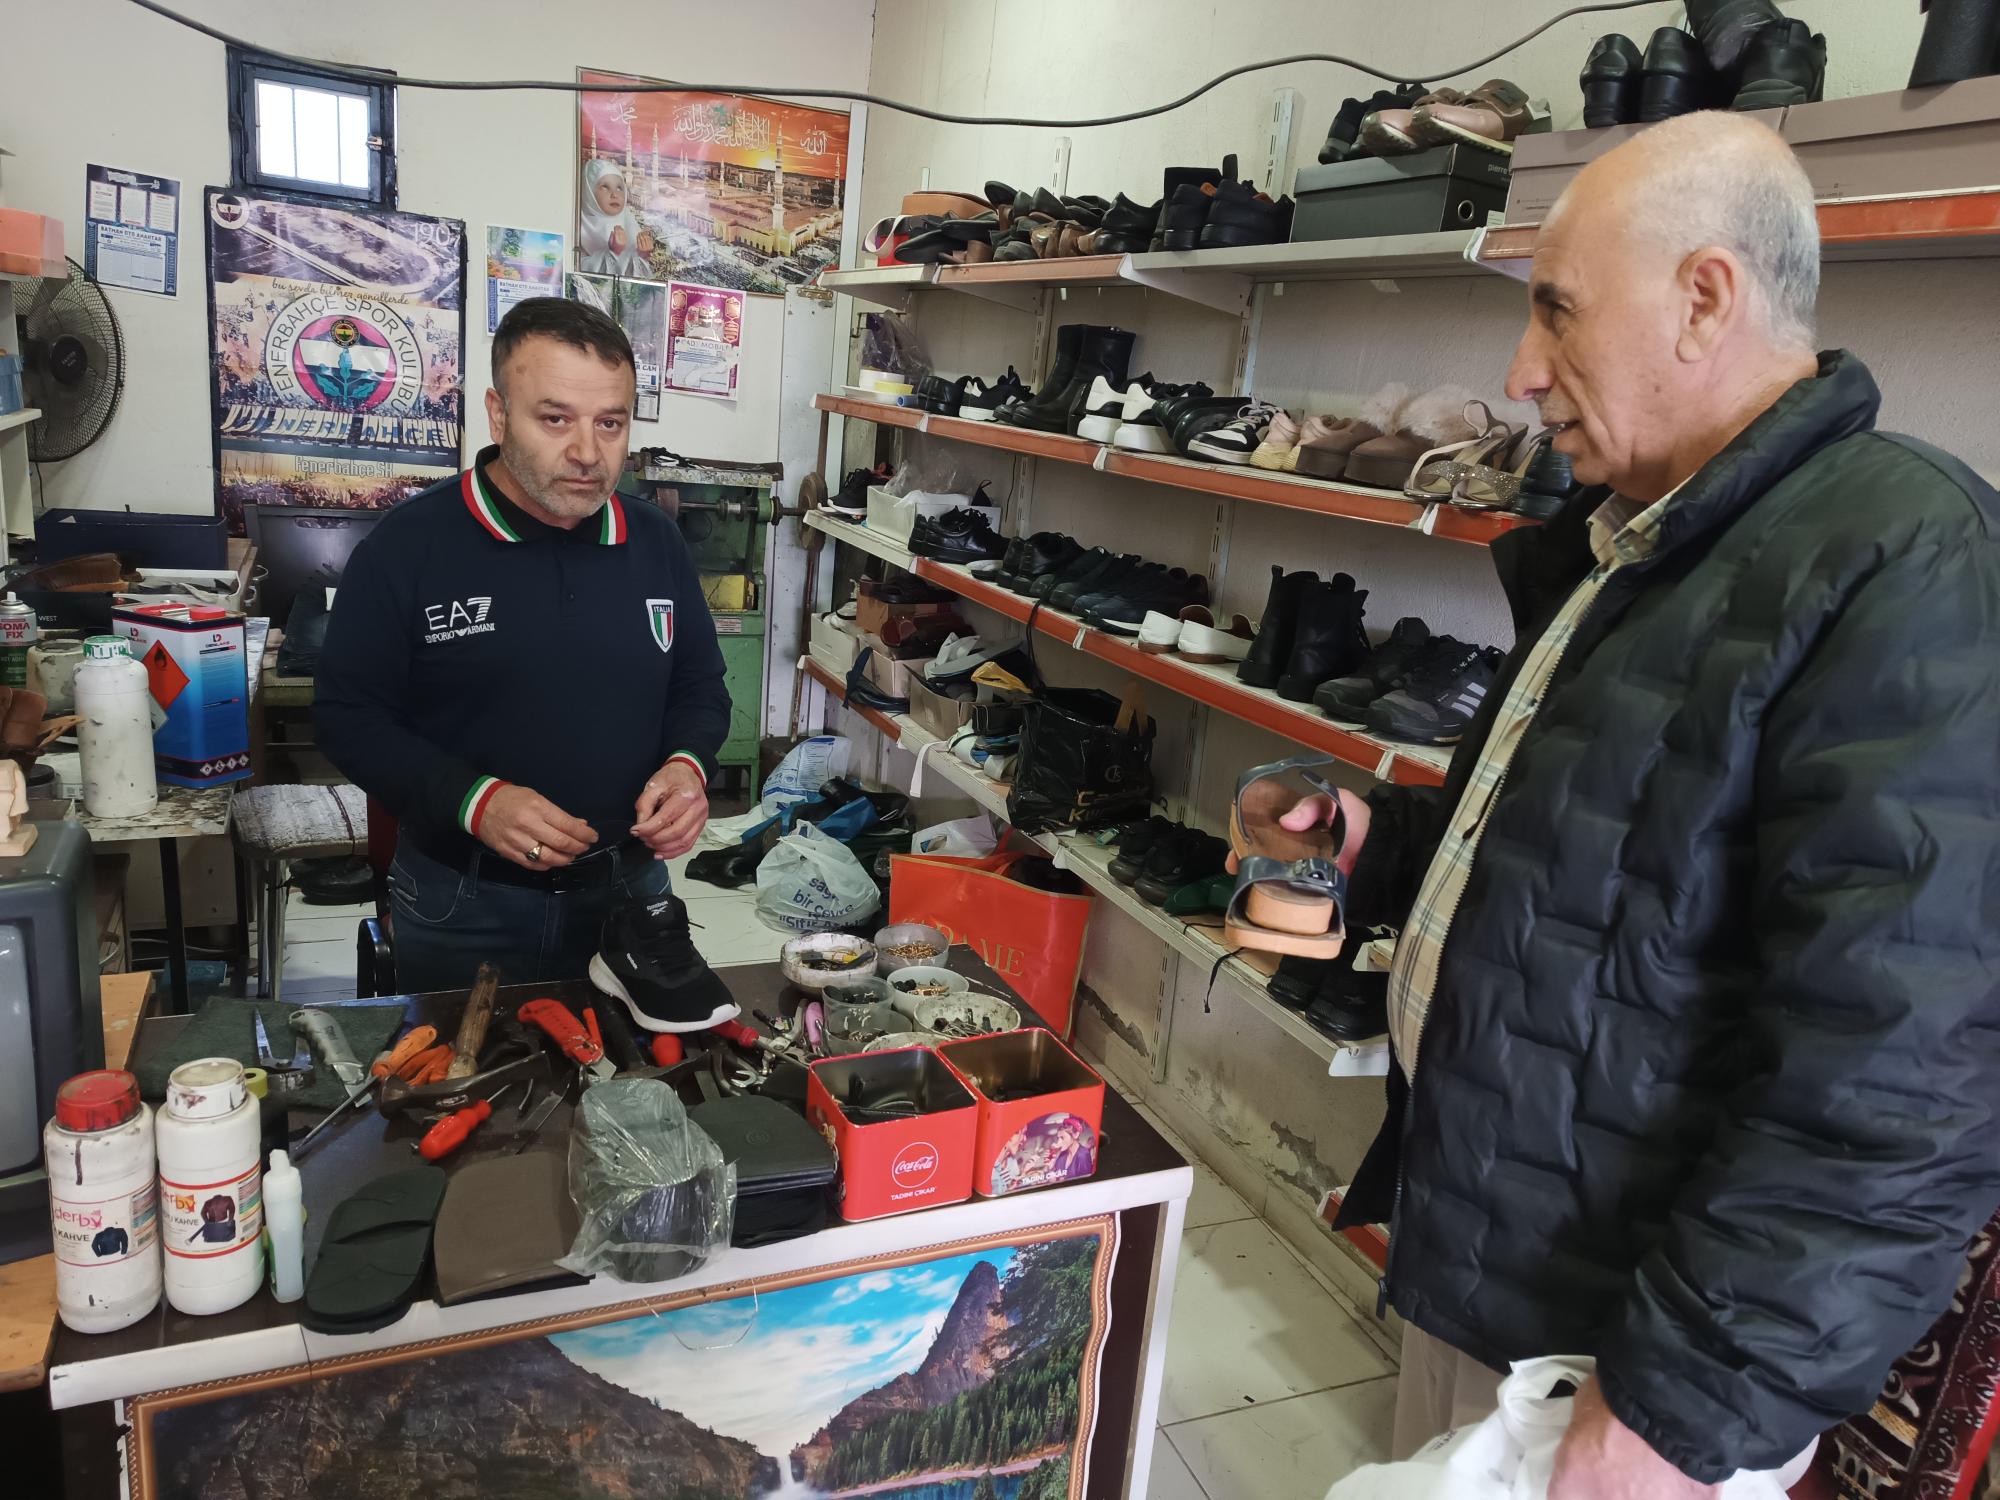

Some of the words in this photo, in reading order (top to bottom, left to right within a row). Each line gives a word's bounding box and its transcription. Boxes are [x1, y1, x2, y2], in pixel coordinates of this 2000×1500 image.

[345, 297, 400, 337] SPOR
[424, 597, 492, 631] EA7
[653, 605, 671, 613] ITALIA
[6, 631, 24, 639] FIX
[424, 630, 455, 644] EMPORIO
[467, 622, 496, 636] ARMANI
[793, 889, 814, 908] bir
[891, 1190, 914, 1201] TADINI
[914, 1186, 936, 1198] ÇIKAR
[54, 1206, 103, 1230] derby
[174, 1214, 200, 1227] KAHVE
[57, 1231, 90, 1243] KAHVE
